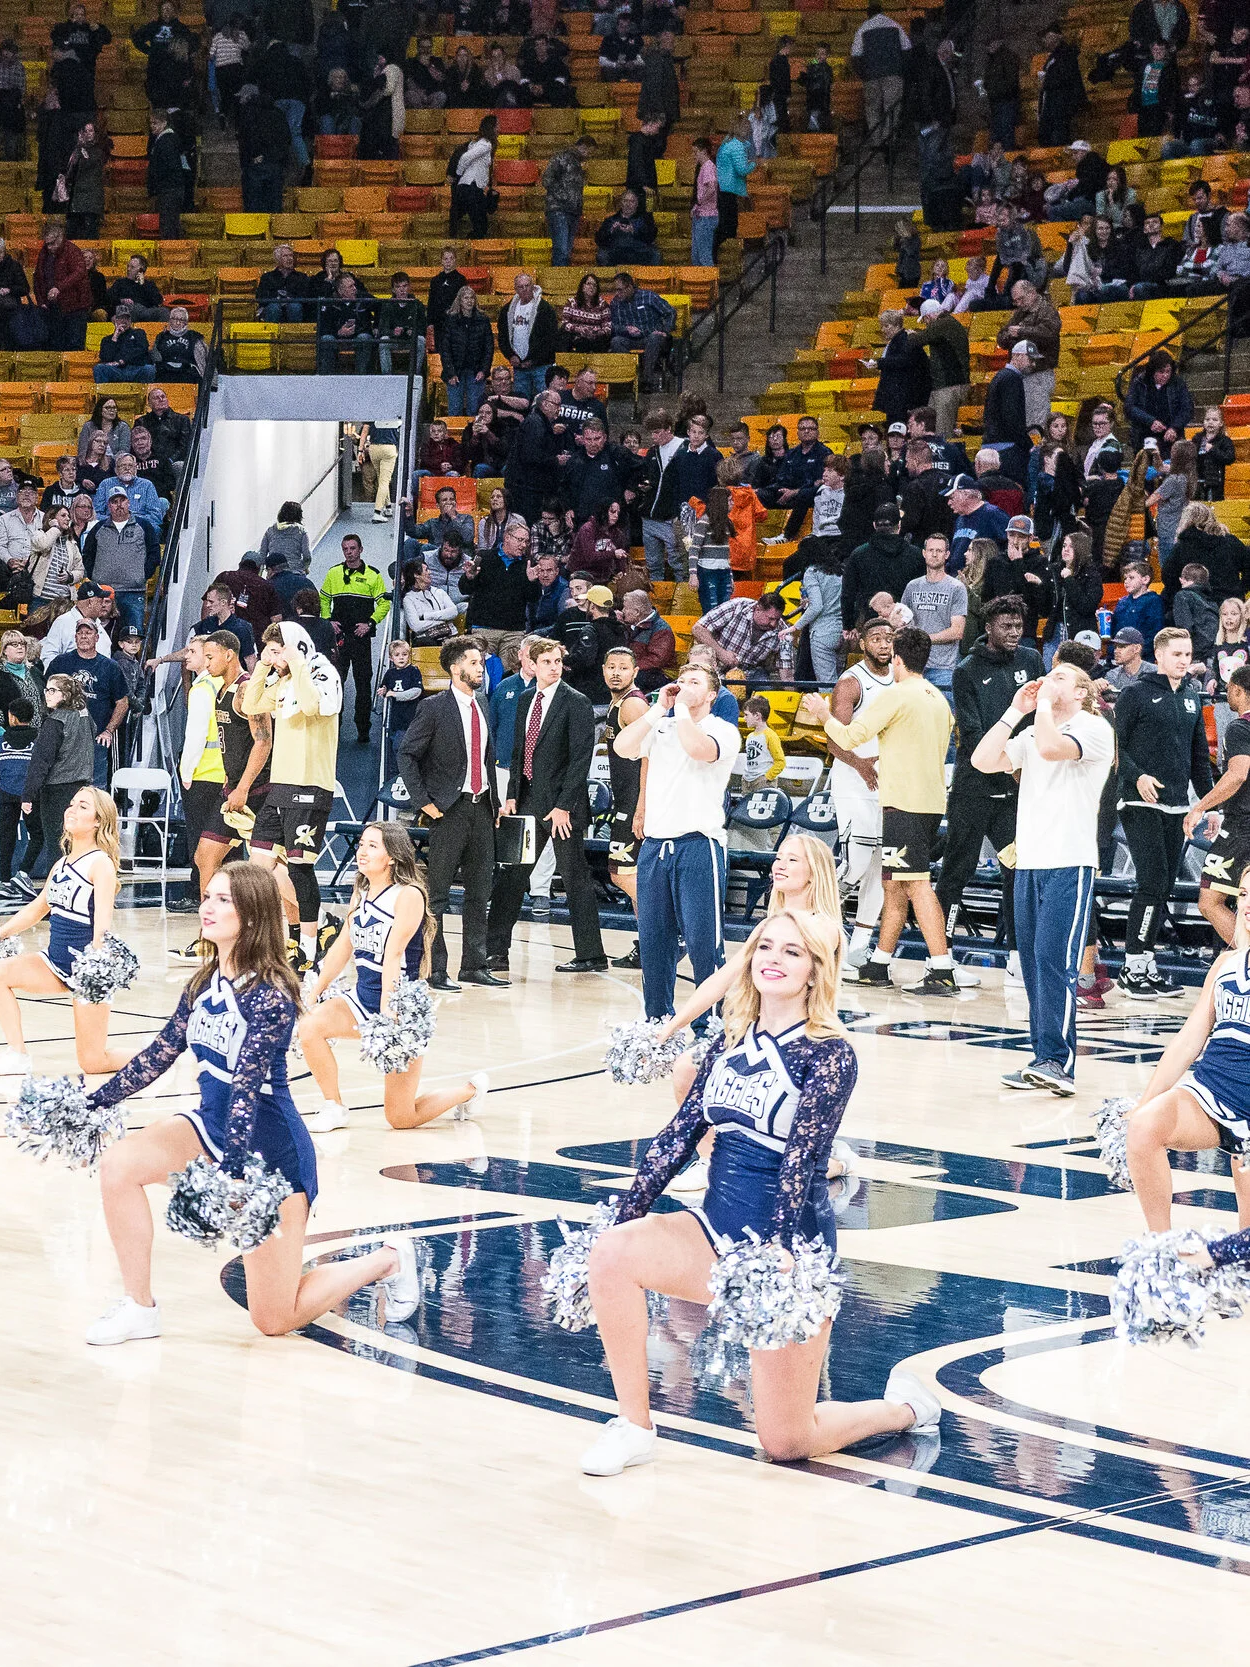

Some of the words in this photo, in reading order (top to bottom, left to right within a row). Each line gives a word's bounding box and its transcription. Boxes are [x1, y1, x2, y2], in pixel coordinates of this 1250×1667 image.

[927, 593, 949, 605] STATE
[946, 903, 958, 938] AGGIES
[705, 1066, 777, 1120] AGGIES
